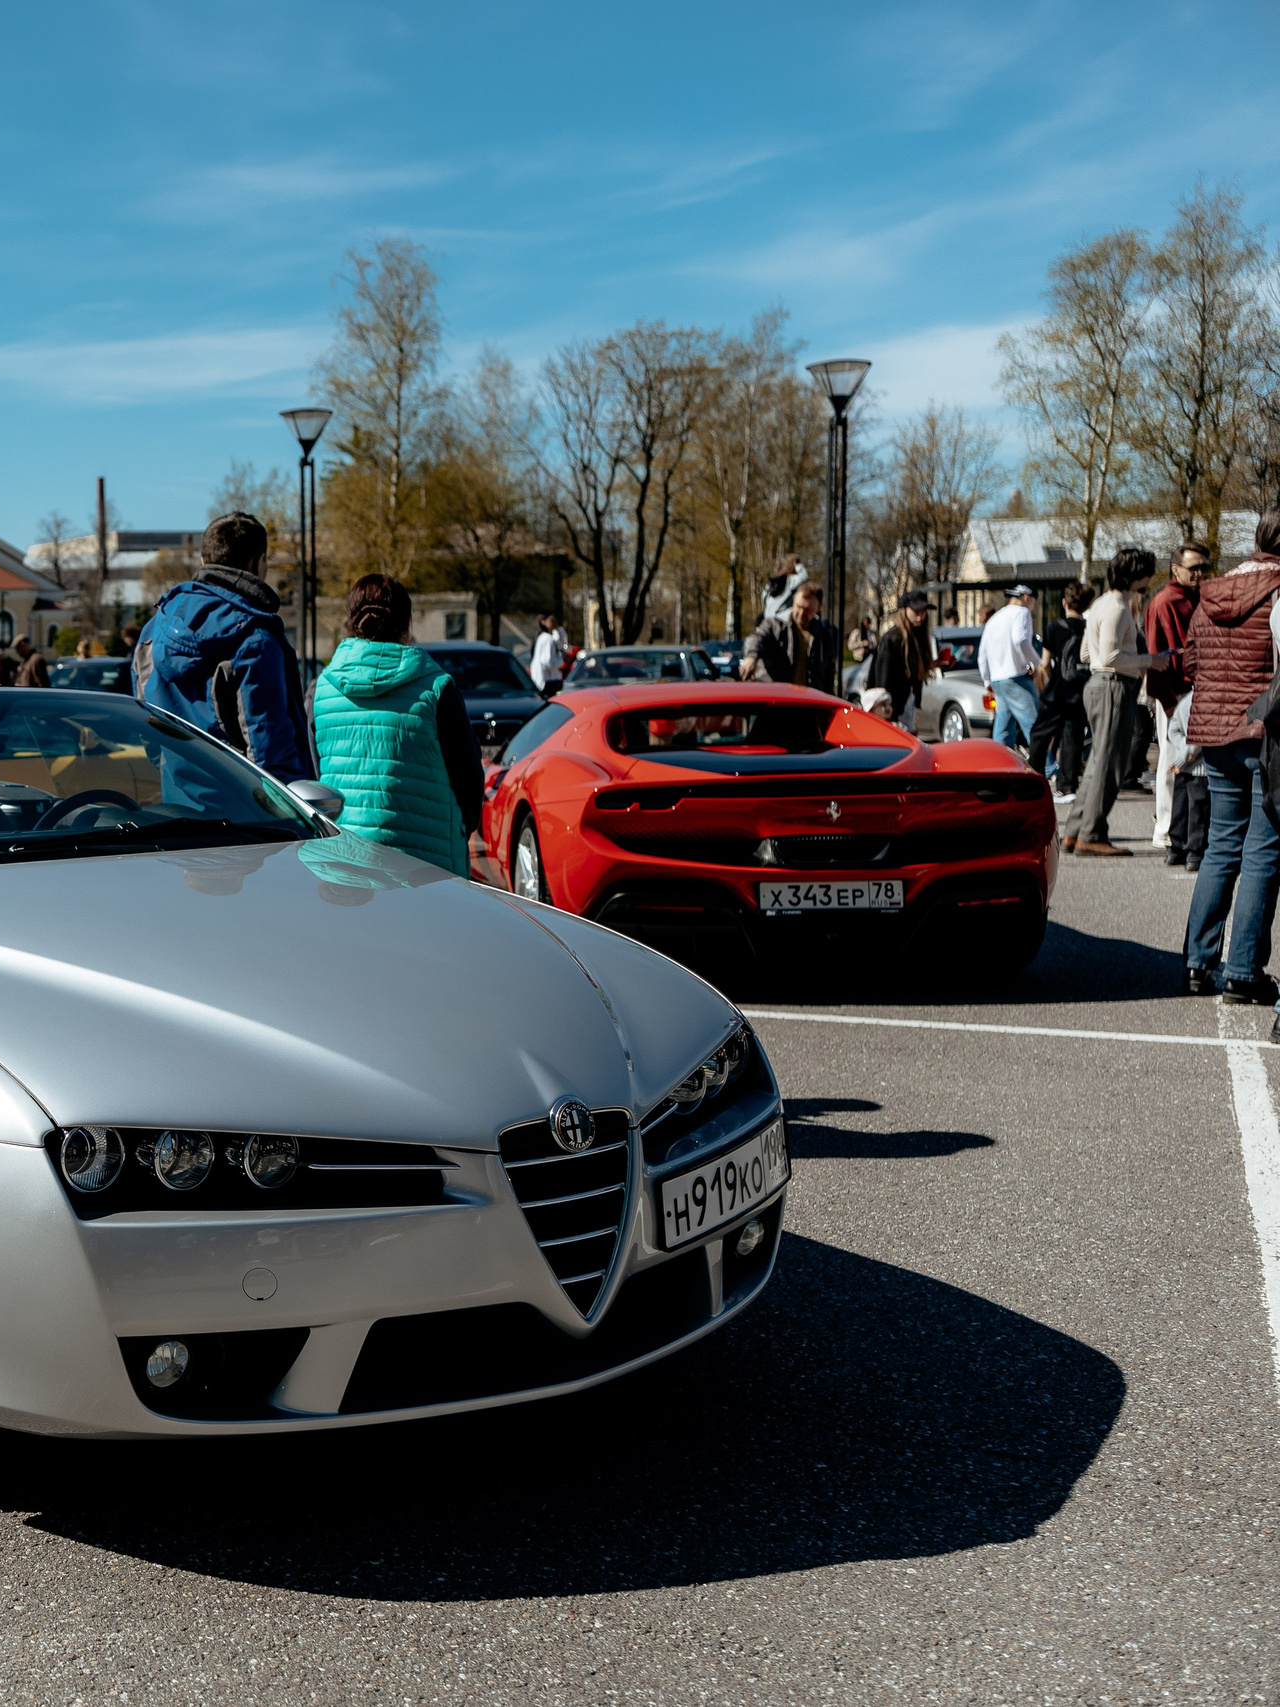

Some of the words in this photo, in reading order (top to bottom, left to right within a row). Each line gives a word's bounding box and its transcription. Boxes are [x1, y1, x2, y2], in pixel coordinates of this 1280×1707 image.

[770, 884, 865, 907] Х343ЕР
[872, 882, 895, 899] 78
[673, 1156, 763, 1237] Н919КО
